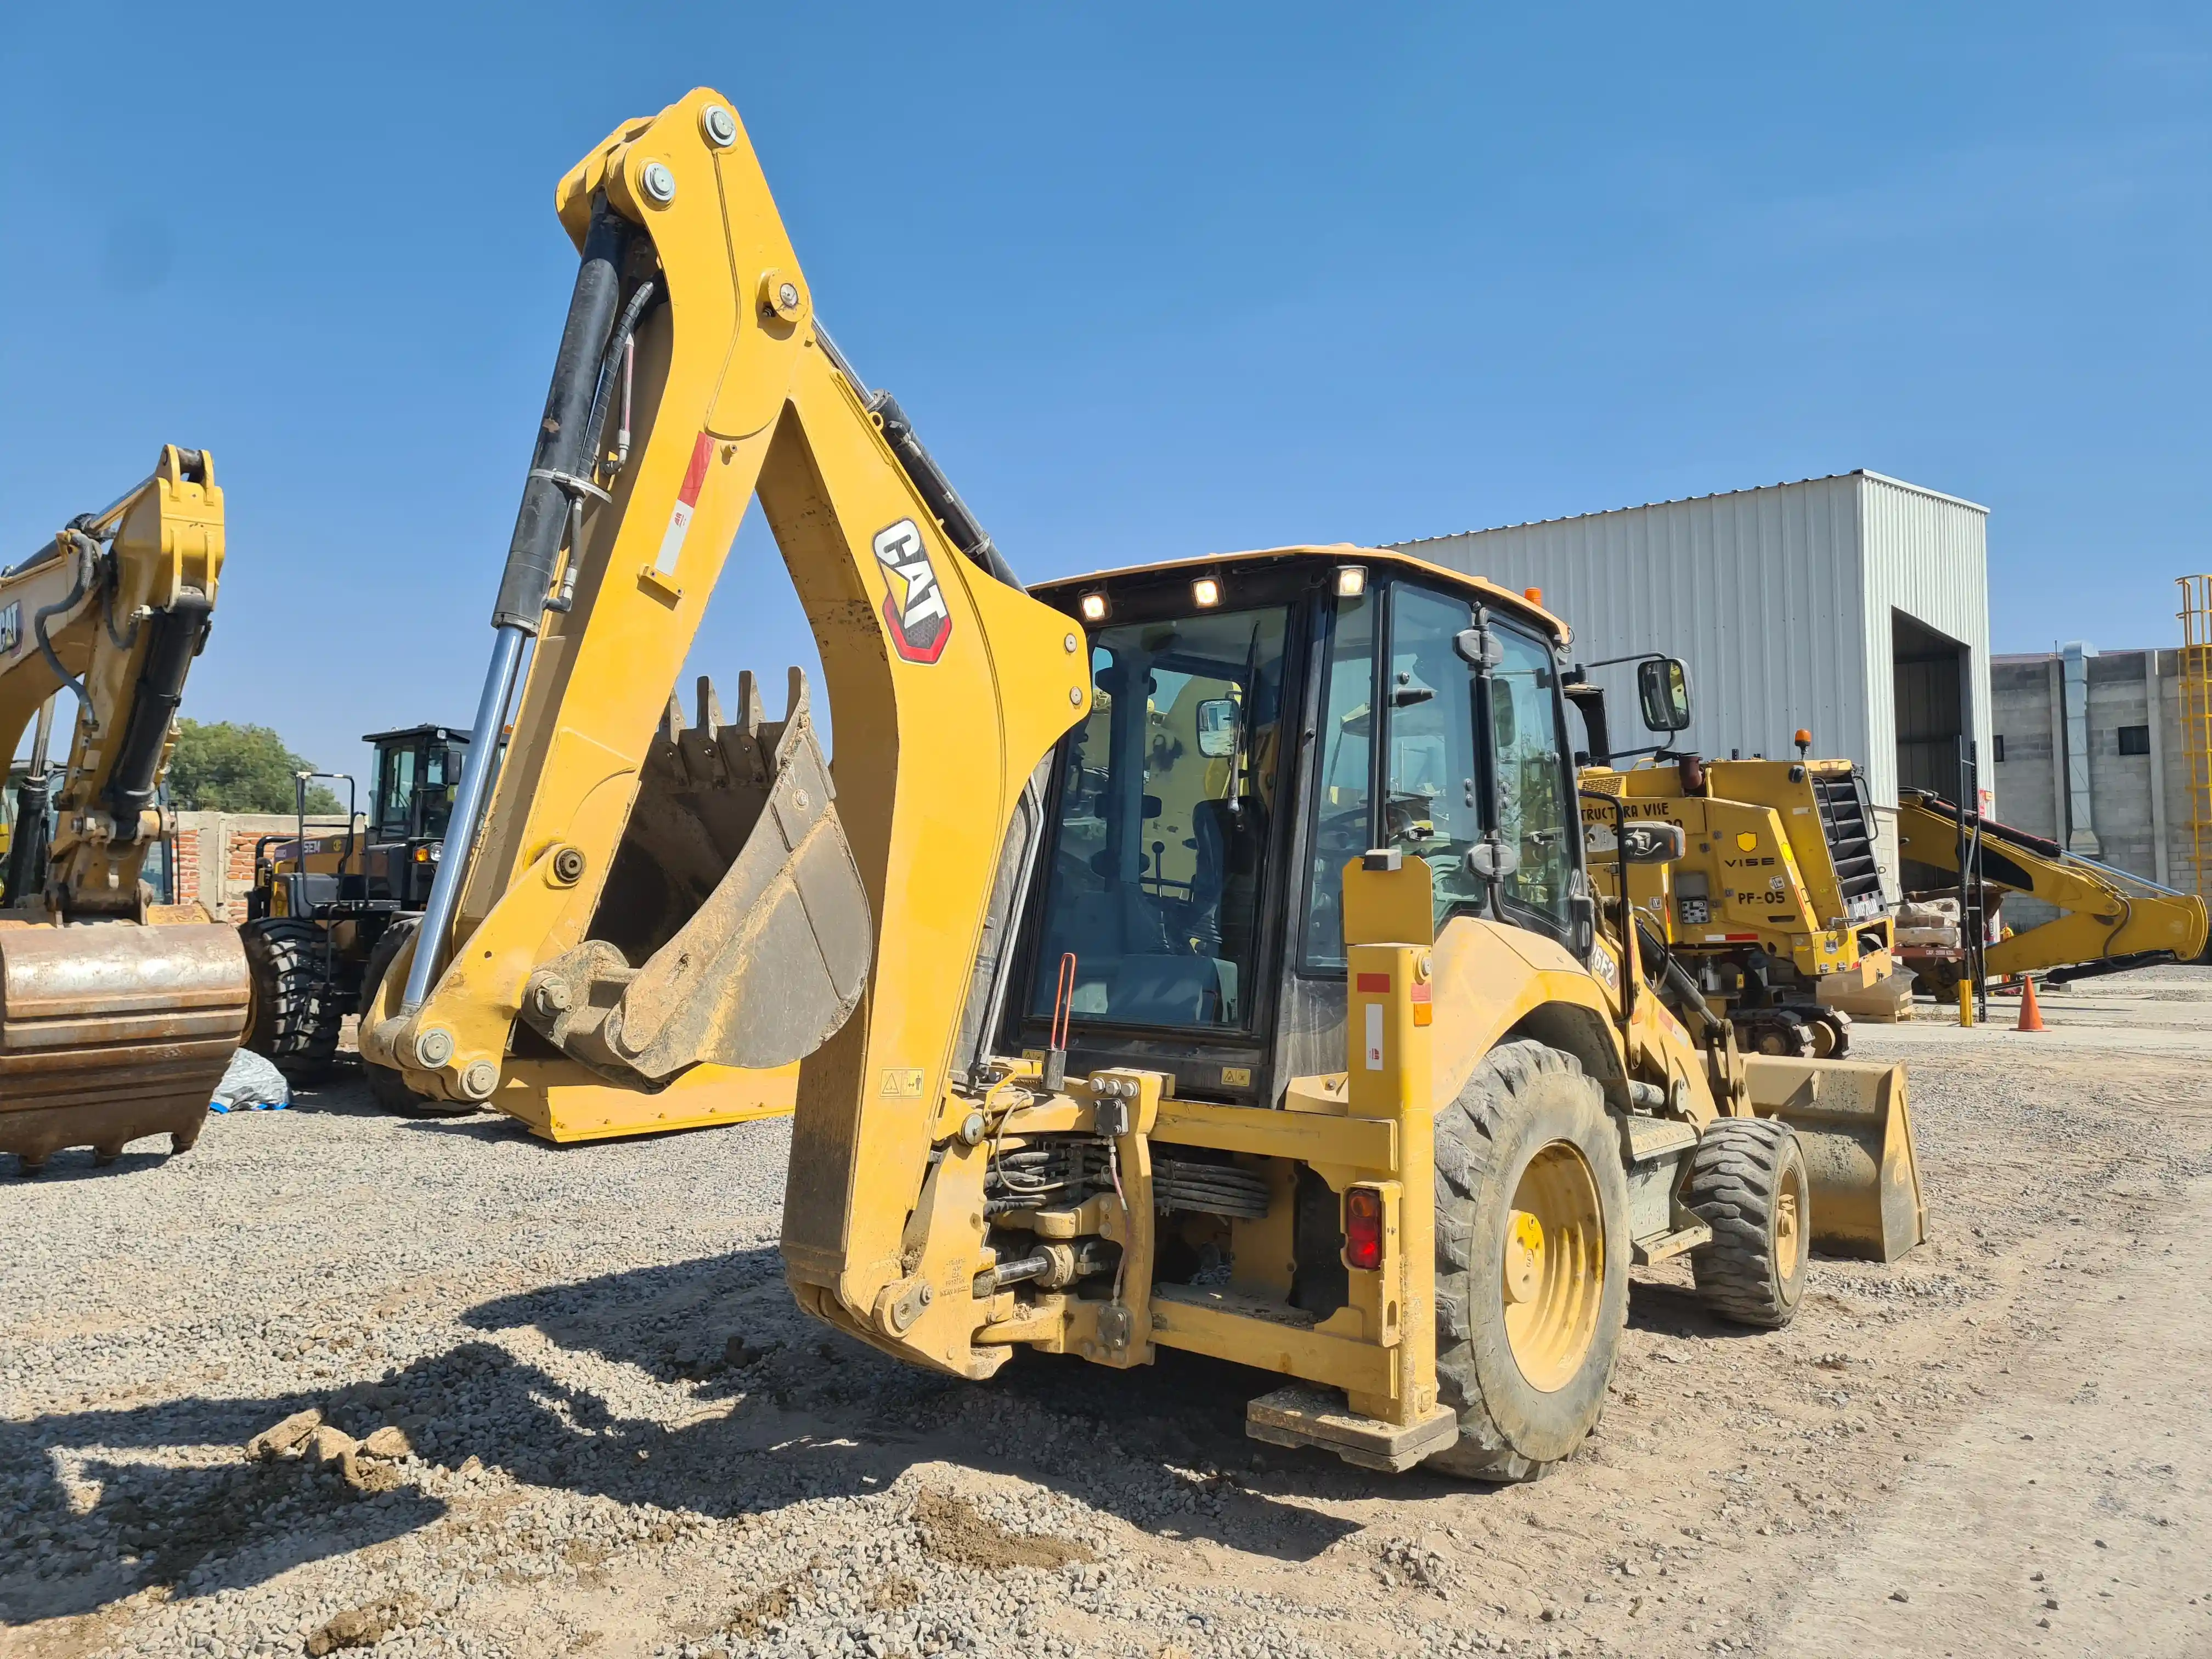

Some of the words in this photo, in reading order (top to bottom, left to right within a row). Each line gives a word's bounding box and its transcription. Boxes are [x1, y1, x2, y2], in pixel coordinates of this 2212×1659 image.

[874, 520, 947, 629] CAT
[1644, 802, 1669, 816] VISE
[1724, 857, 1775, 867] VISE
[1738, 891, 1785, 905] PF-05
